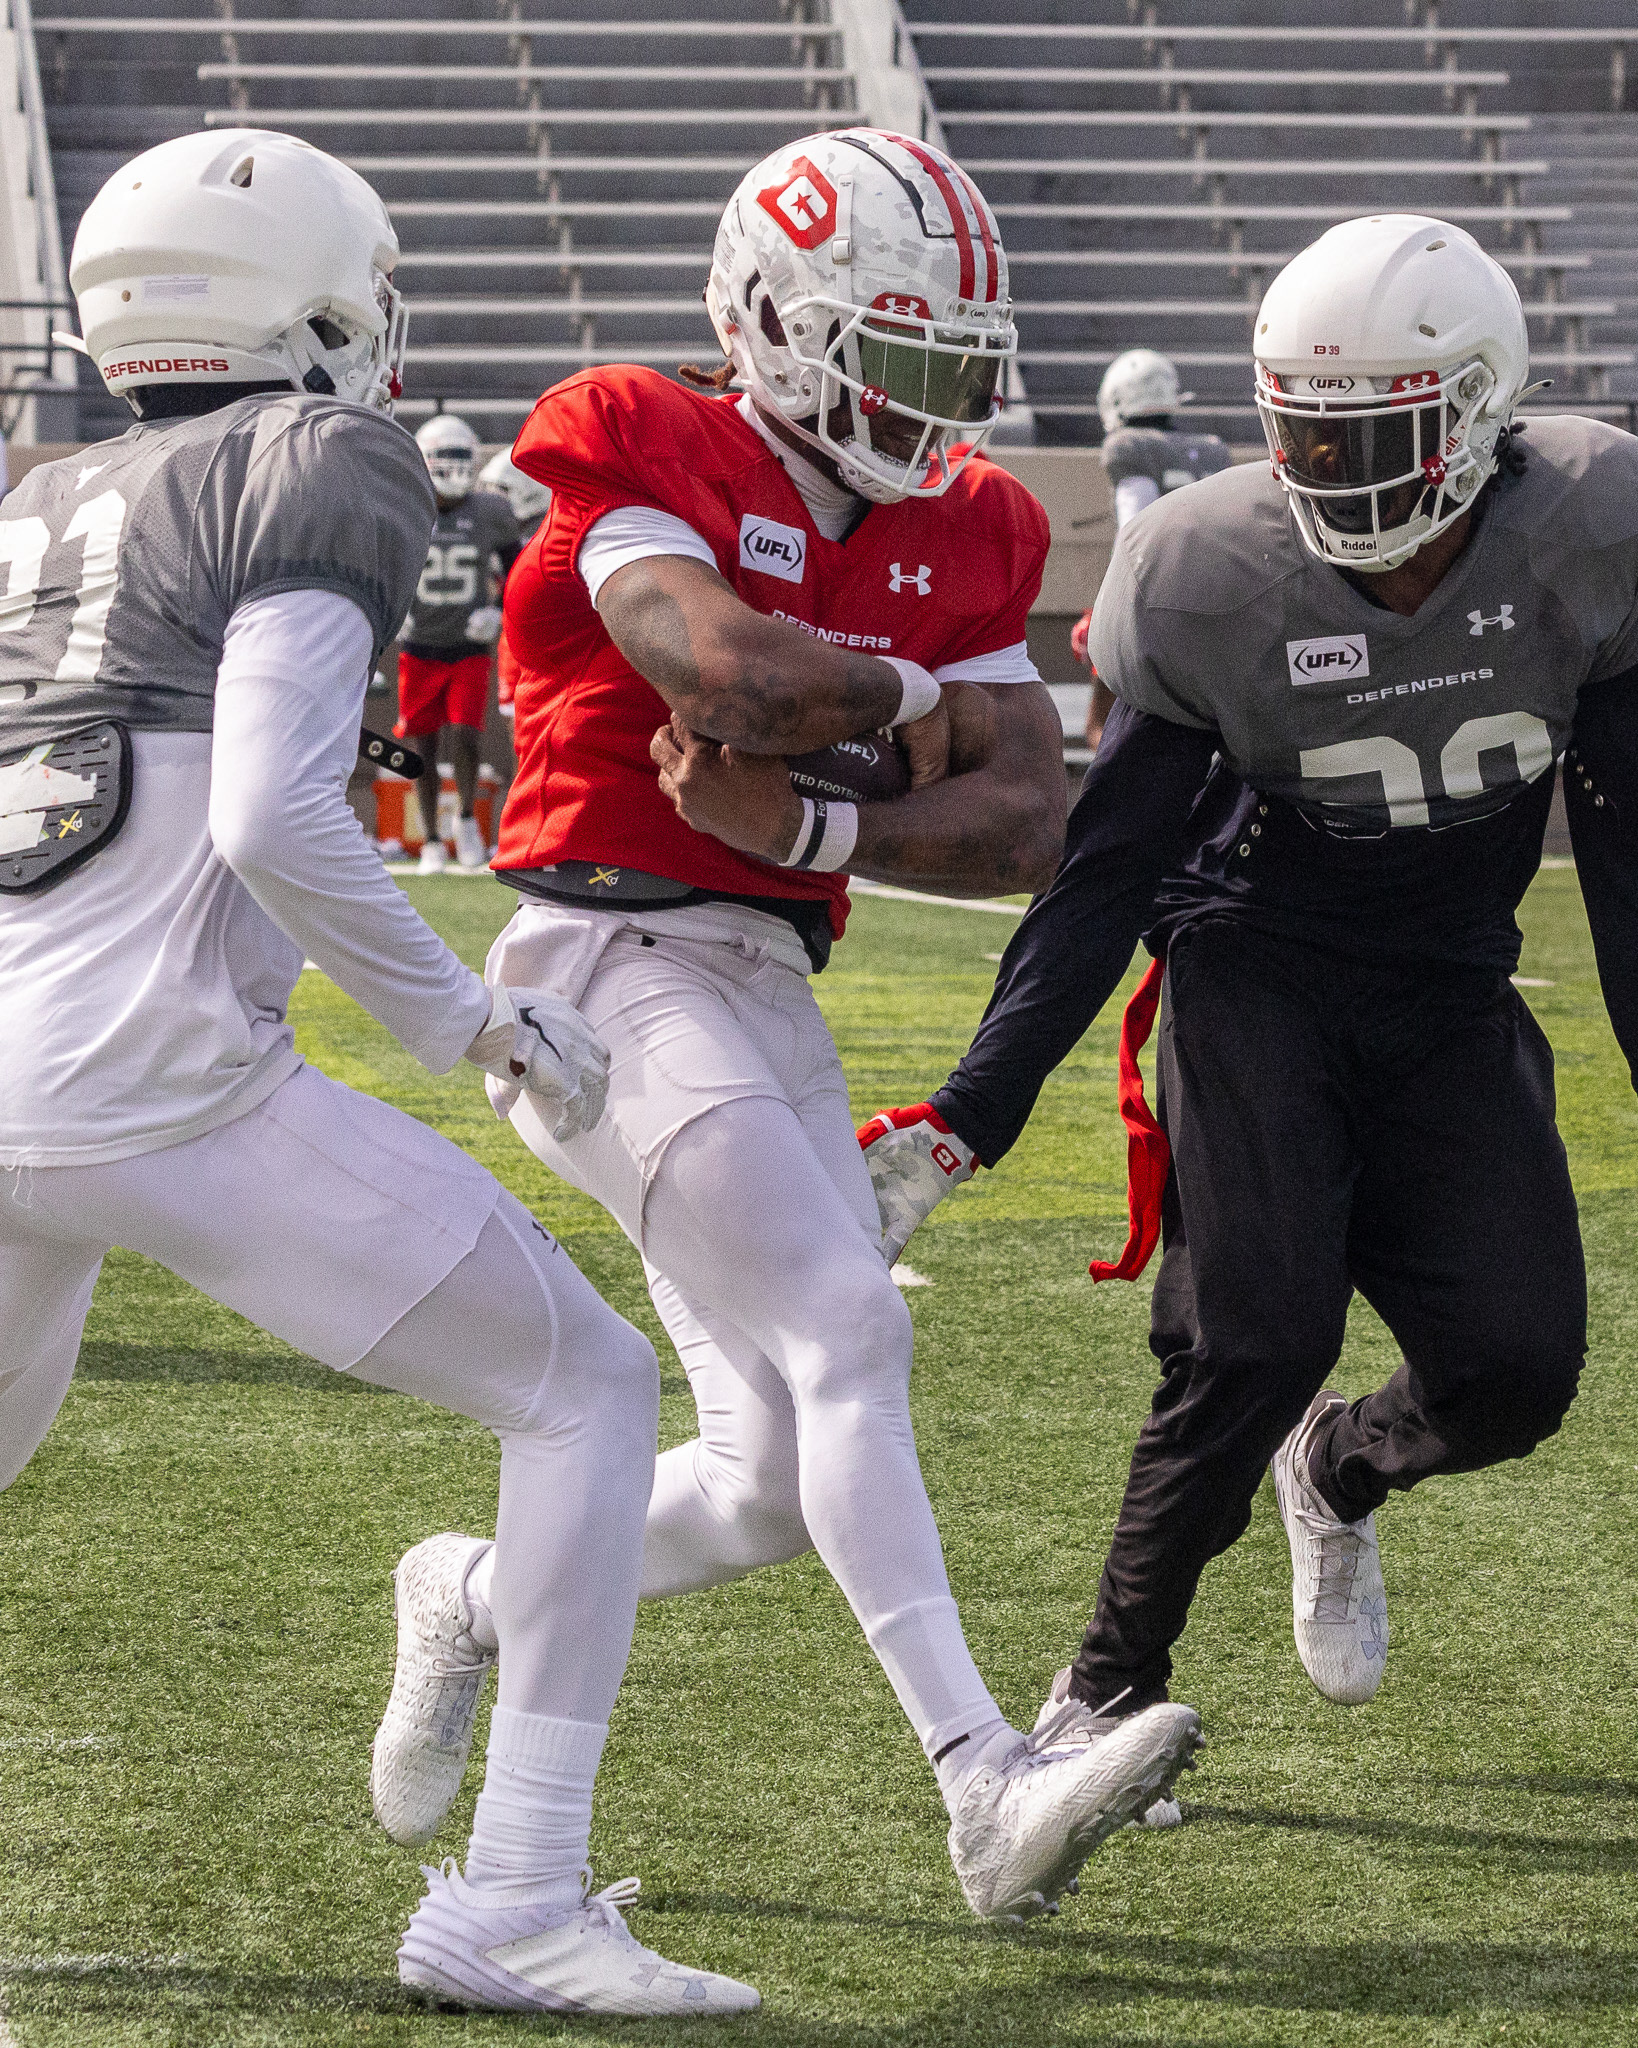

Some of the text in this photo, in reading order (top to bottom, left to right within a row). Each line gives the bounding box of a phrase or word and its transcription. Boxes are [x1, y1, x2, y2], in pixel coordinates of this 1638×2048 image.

[1329, 345, 1340, 356] 39
[103, 358, 230, 381] DEFENDERS
[1340, 539, 1378, 551] Riddel
[416, 544, 479, 605] 25
[1347, 668, 1494, 704] DEFENDERS
[789, 770, 864, 802] ITED FOOTBAL
